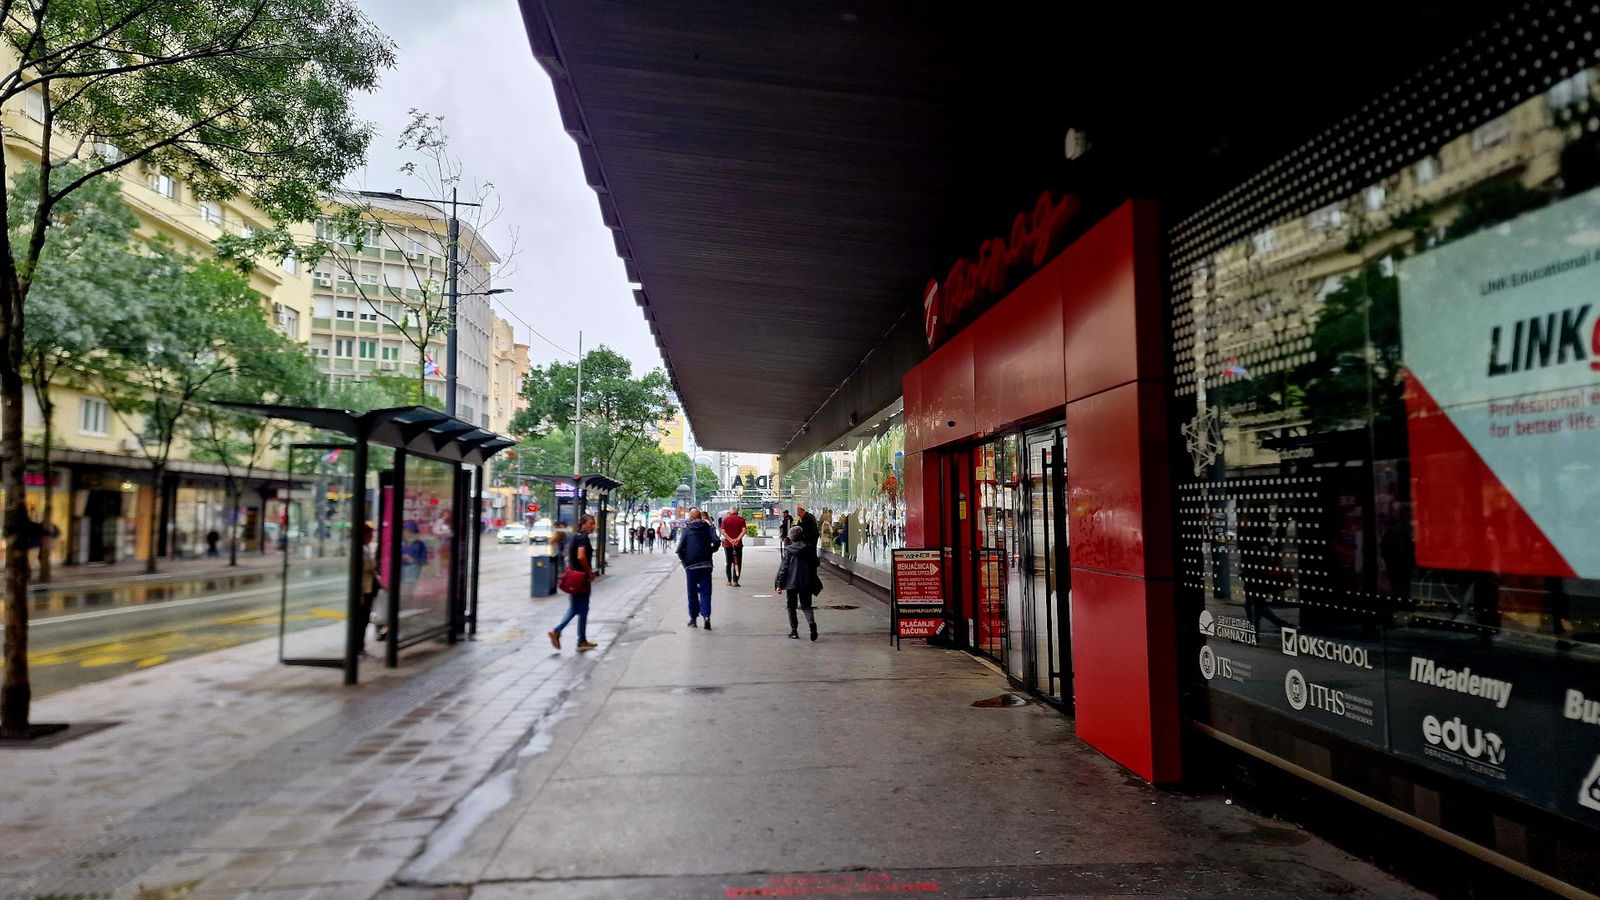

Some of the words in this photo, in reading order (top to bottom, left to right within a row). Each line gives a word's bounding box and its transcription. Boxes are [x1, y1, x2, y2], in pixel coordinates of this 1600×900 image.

[1511, 251, 1591, 288] Educational
[1488, 303, 1600, 378] LINK
[1488, 390, 1586, 417] Professional
[1489, 420, 1510, 439] for
[1513, 417, 1564, 436] better
[1567, 411, 1595, 431] life
[900, 619, 935, 628] PLAĆANJE
[901, 627, 929, 635] RAČUNA
[1216, 626, 1257, 646] GIMNAZIJA
[1299, 634, 1373, 669] OKSCHOOL
[1216, 656, 1233, 679] ITS
[1409, 656, 1513, 708] ITAcademy
[1309, 682, 1346, 716] ITHS
[1563, 688, 1600, 726] Bu
